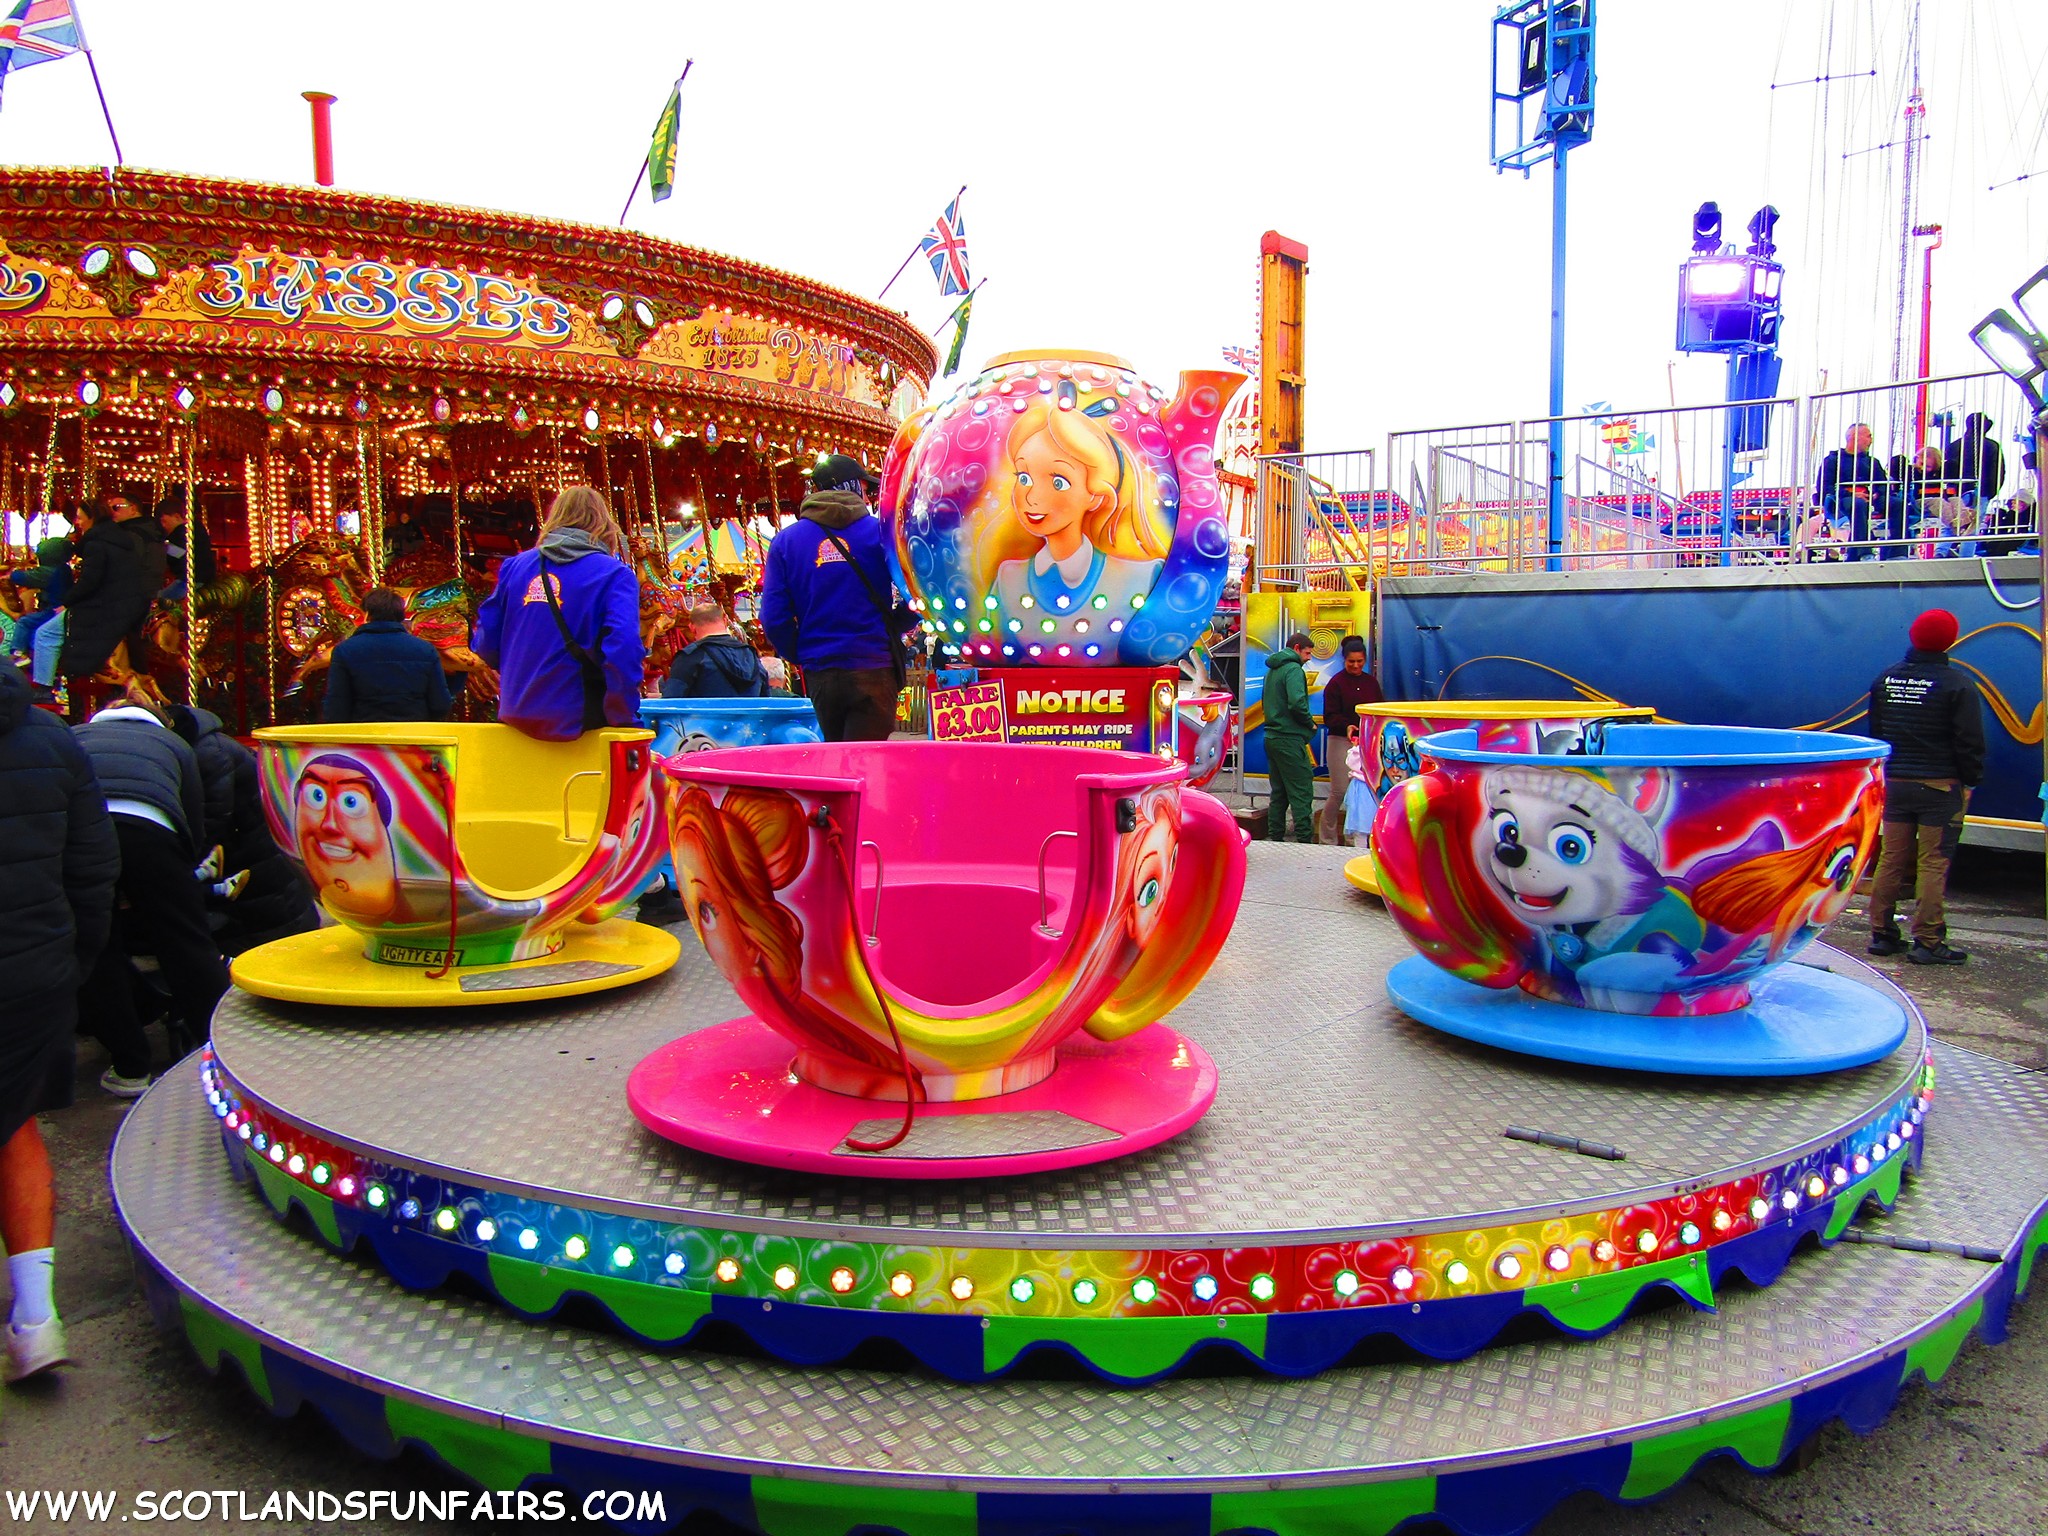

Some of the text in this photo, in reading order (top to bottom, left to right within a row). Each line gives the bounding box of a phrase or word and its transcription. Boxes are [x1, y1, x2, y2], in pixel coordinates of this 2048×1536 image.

[190, 253, 573, 345] CLASSES
[702, 346, 761, 370] 1875
[934, 686, 999, 710] FARE
[1016, 689, 1126, 714] NOTICE
[937, 705, 1001, 738] £3.00
[1009, 724, 1133, 736] PARENTS MAY RIDE
